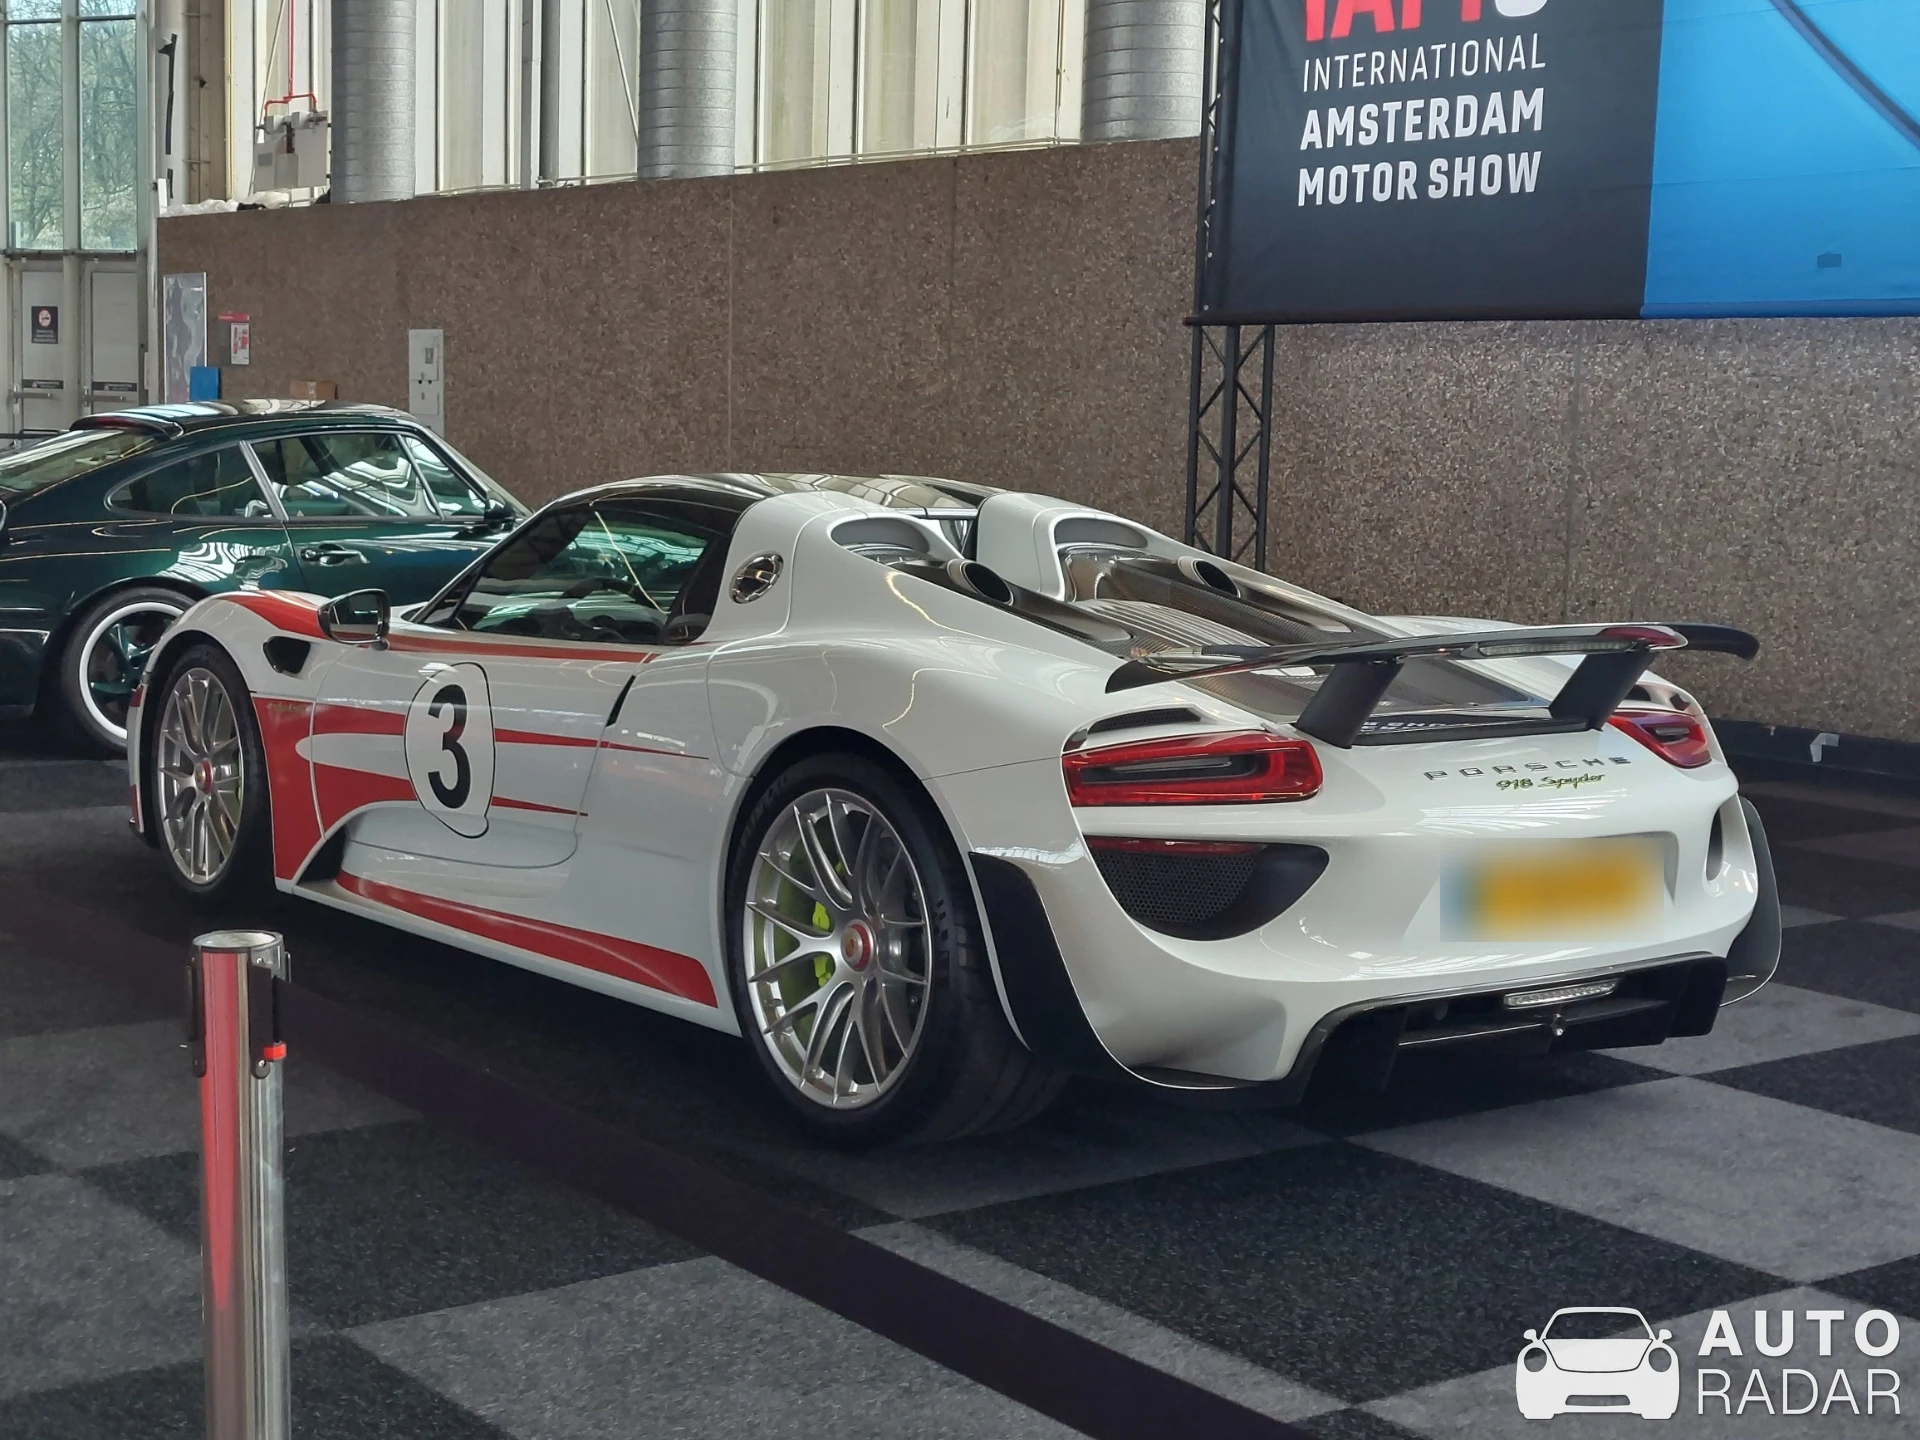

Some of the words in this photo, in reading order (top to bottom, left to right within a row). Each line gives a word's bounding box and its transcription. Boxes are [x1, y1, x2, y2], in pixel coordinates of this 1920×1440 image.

[1303, 33, 1546, 92] INTERNATIONAL
[1300, 88, 1544, 150] AMSTERDAM
[1298, 160, 1418, 207] MOTOR
[1428, 151, 1542, 199] SHOW
[428, 684, 471, 809] 3
[1424, 756, 1631, 781] PORSCHE
[1496, 778, 1534, 791] 918
[1538, 773, 1605, 789] Spyder
